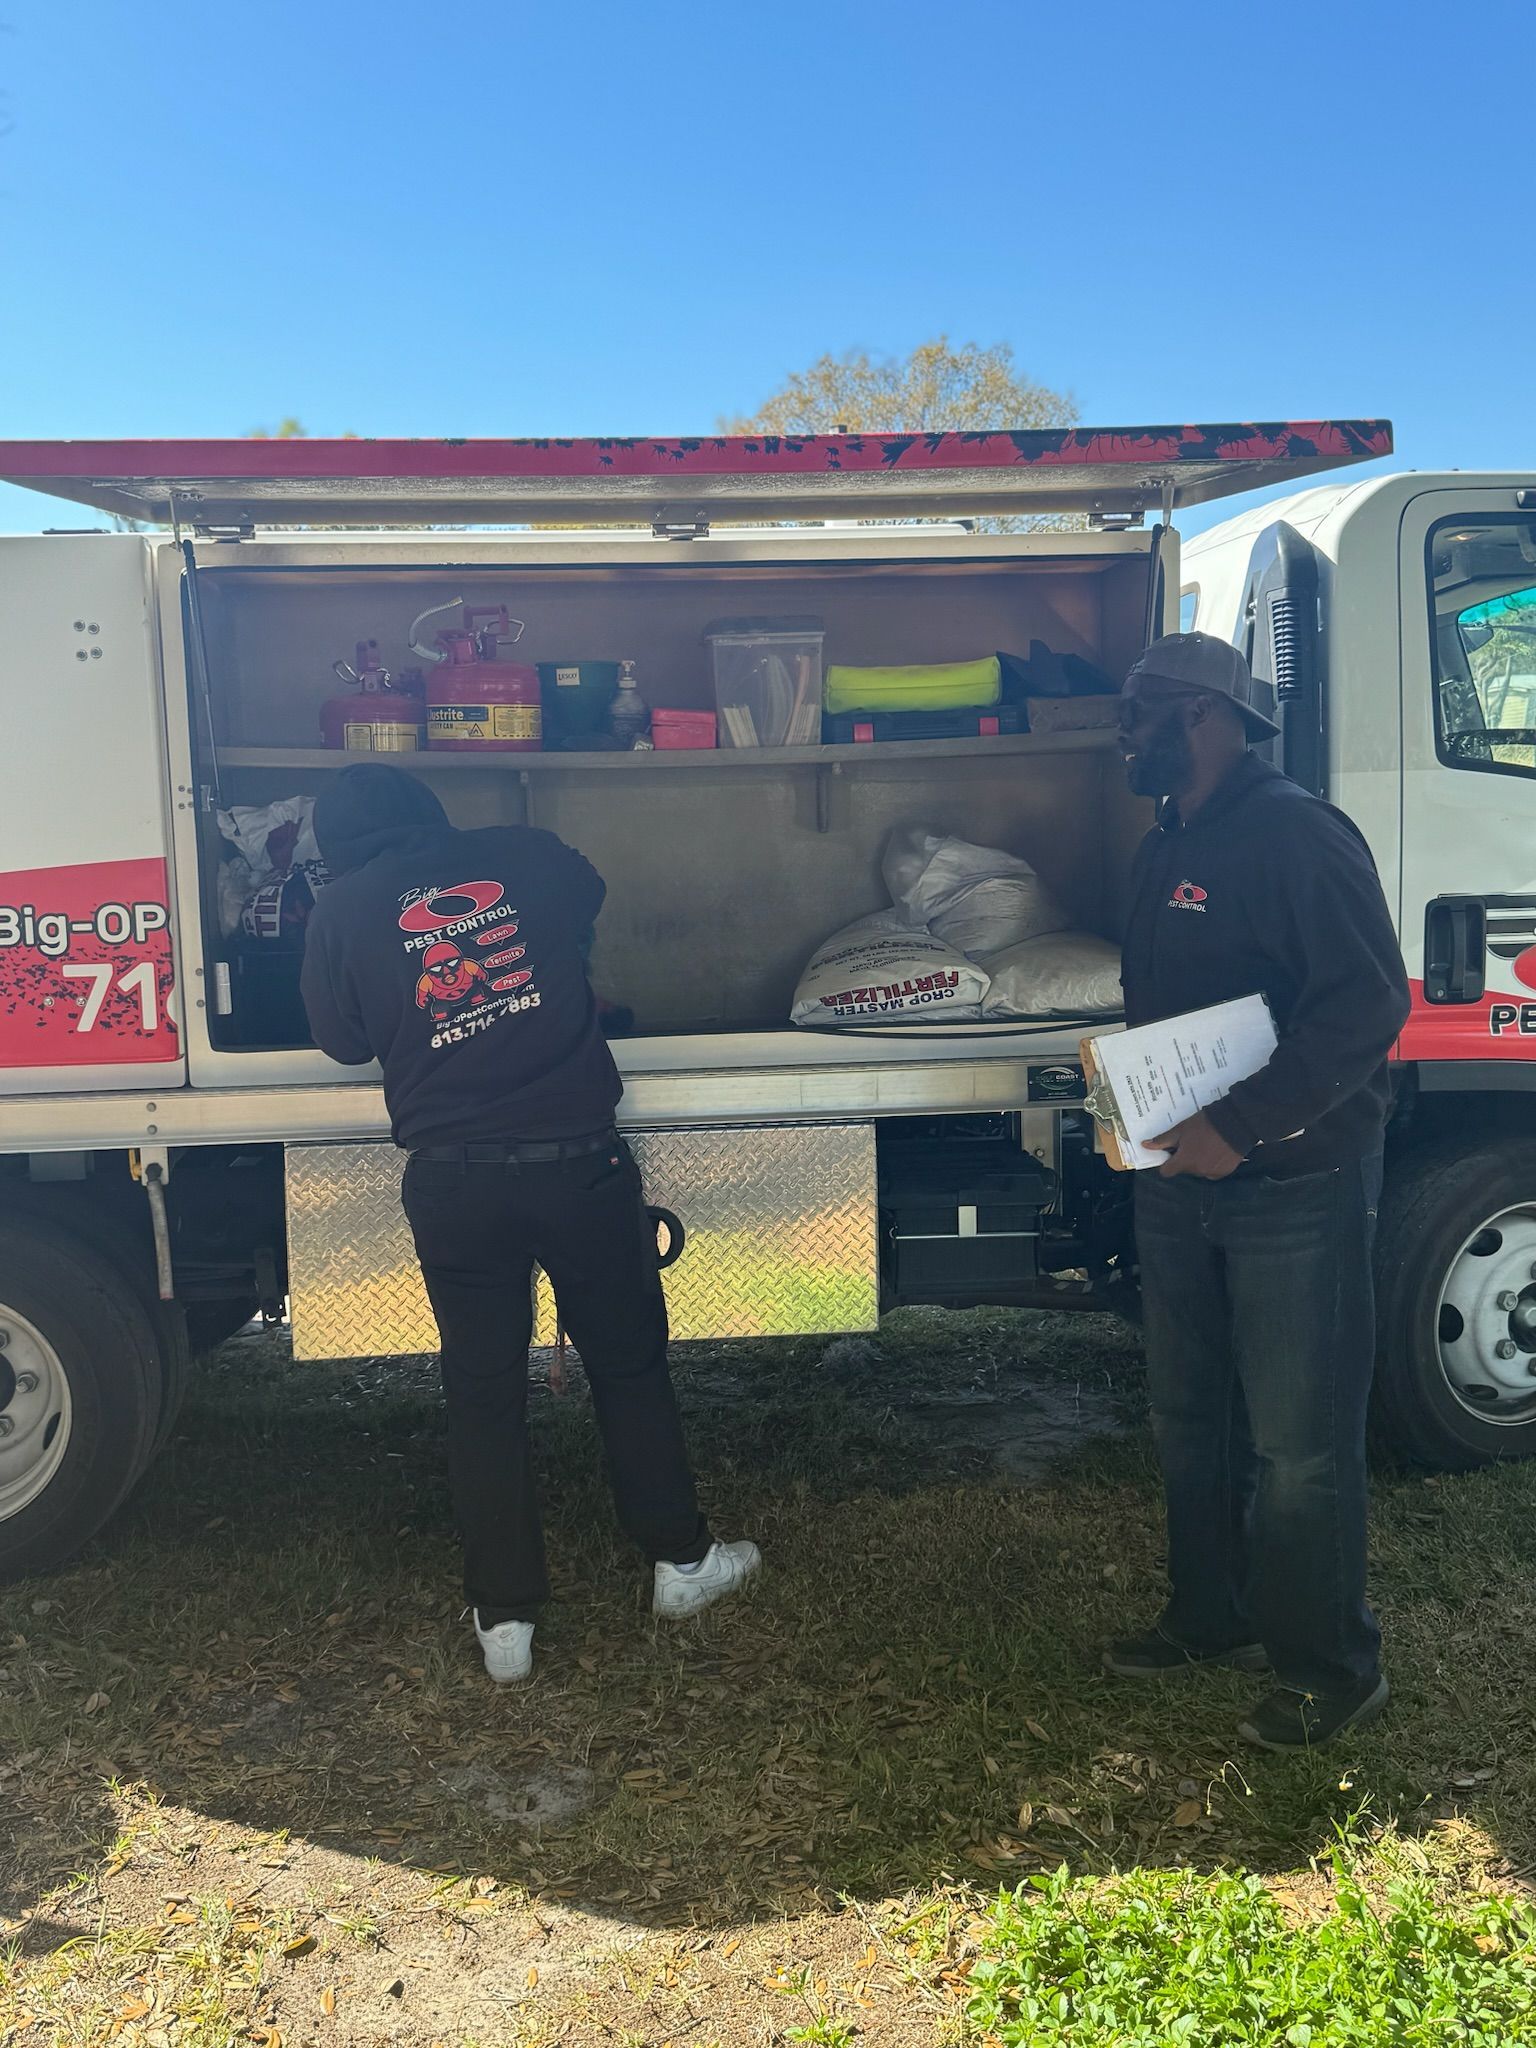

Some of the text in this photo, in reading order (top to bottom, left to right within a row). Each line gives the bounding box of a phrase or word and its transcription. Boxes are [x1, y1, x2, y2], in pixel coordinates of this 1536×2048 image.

[398, 886, 440, 911] Big
[1179, 902, 1207, 913] CONTROL
[0, 903, 173, 956] Big-OP
[403, 904, 518, 953] PEST CONTROL
[486, 928, 509, 941] Lawn
[490, 950, 521, 966] Termite
[502, 975, 521, 987] Pest
[819, 971, 960, 1007] FERTILIZER
[834, 988, 955, 1016] CROP MASTER
